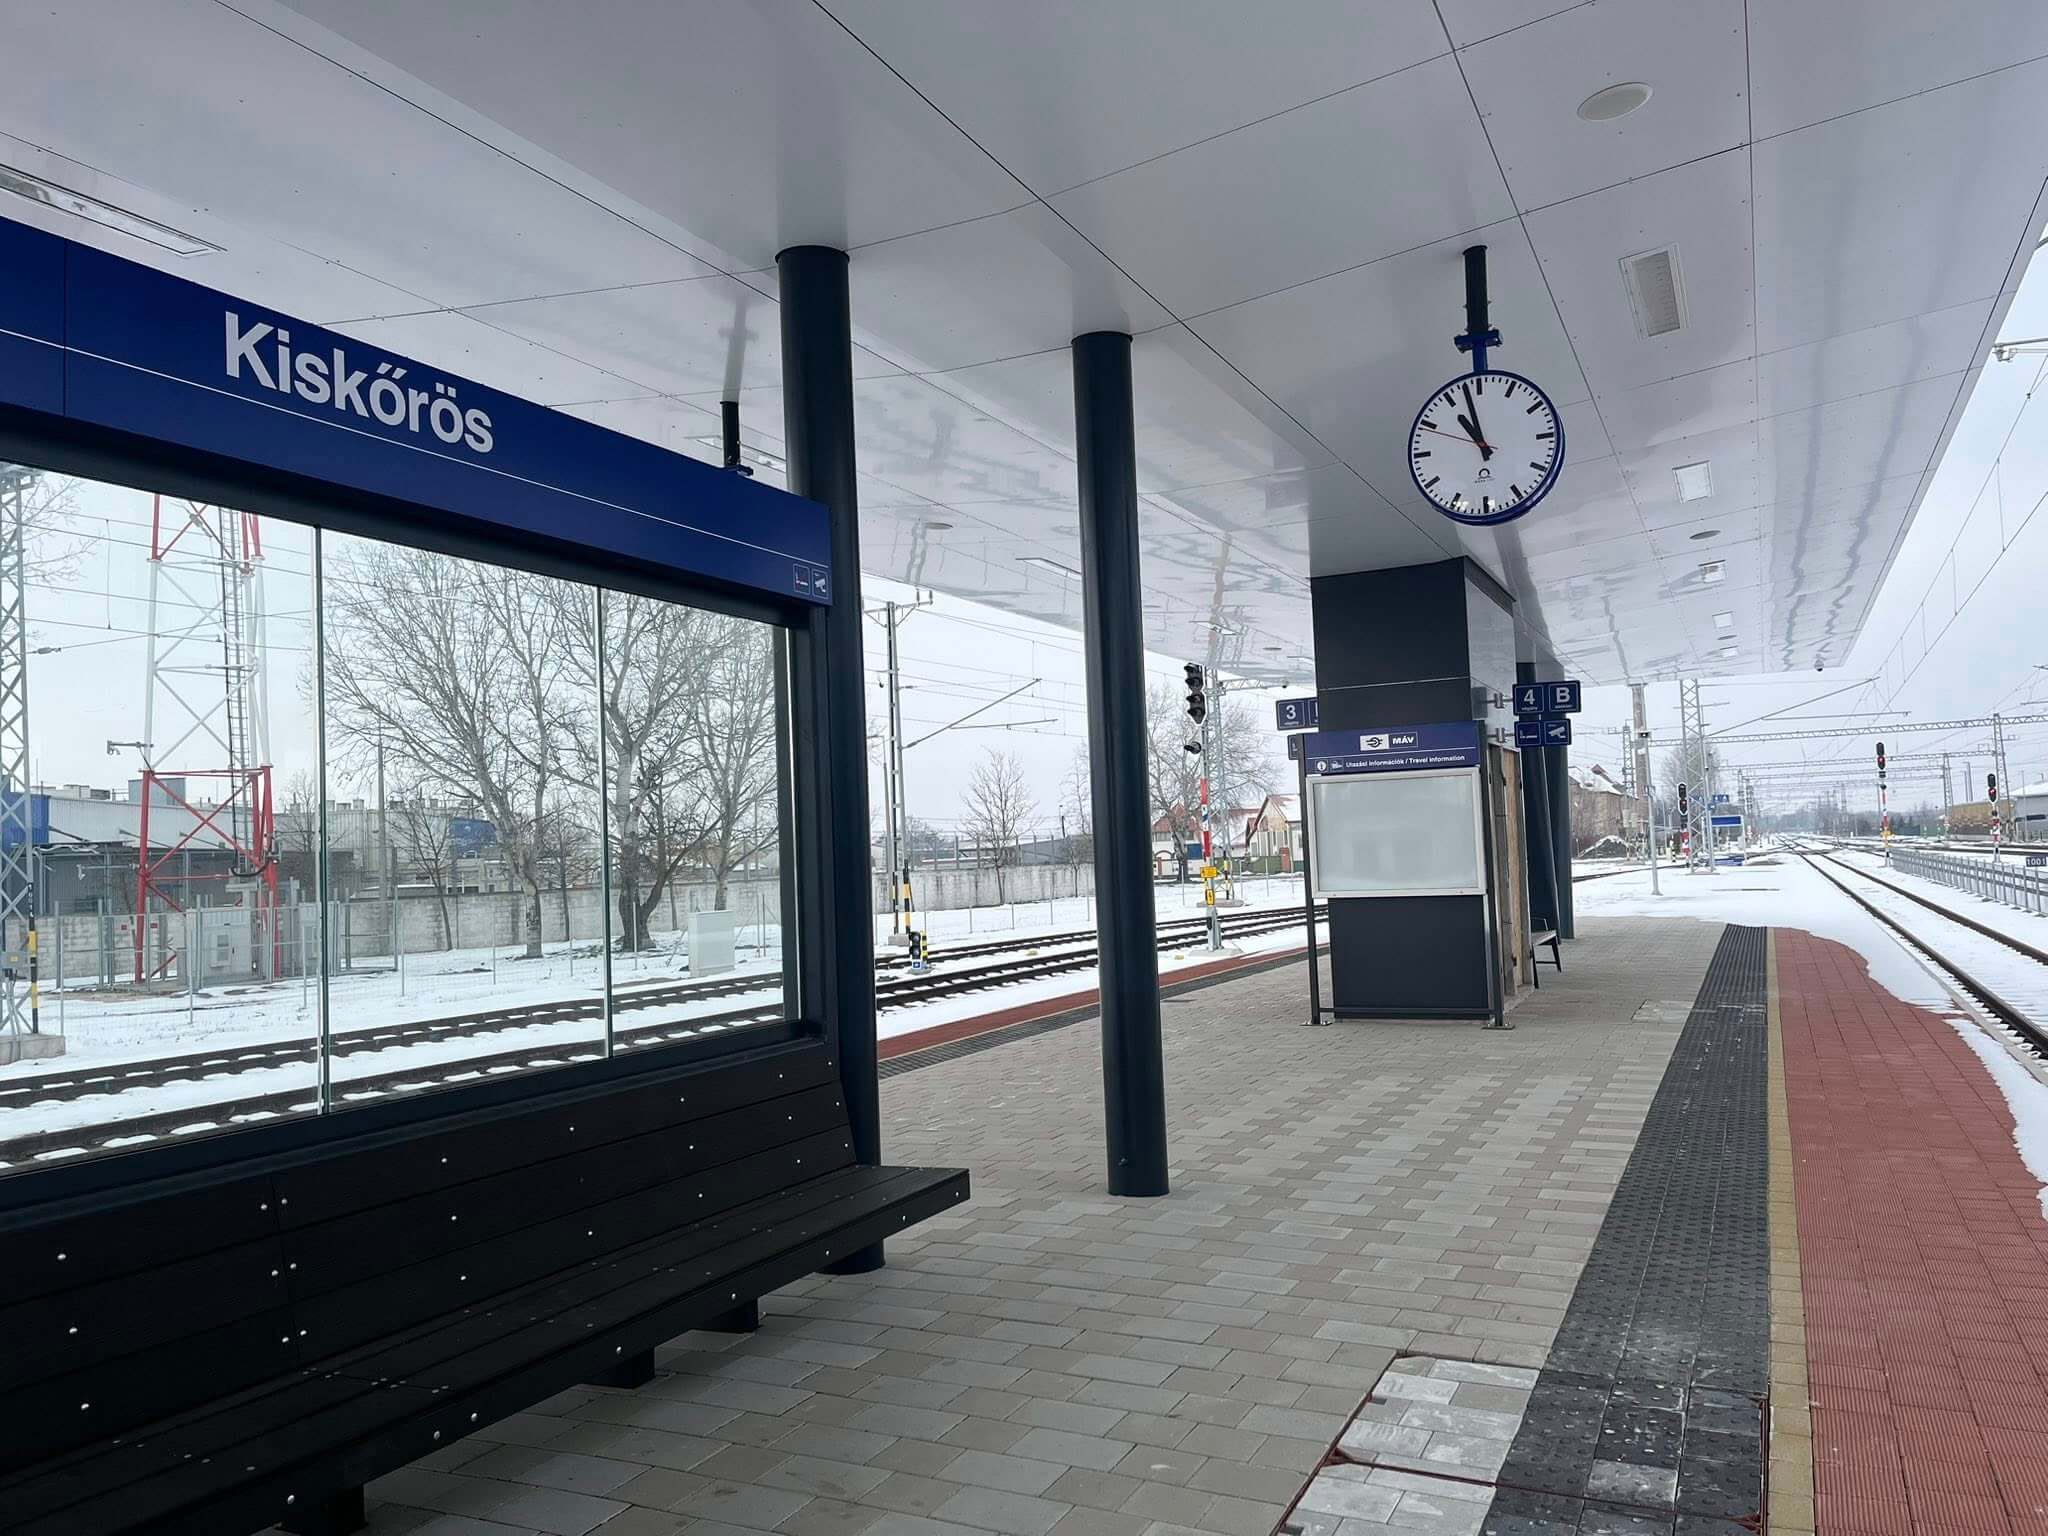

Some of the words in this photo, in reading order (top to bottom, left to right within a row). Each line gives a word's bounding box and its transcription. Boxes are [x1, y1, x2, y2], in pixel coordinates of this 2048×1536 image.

[225, 311, 494, 453] Kiskőrös
[1523, 688, 1536, 705] 4
[1556, 686, 1571, 704] B
[1285, 704, 1297, 720] 3
[1392, 735, 1415, 745] MÁV
